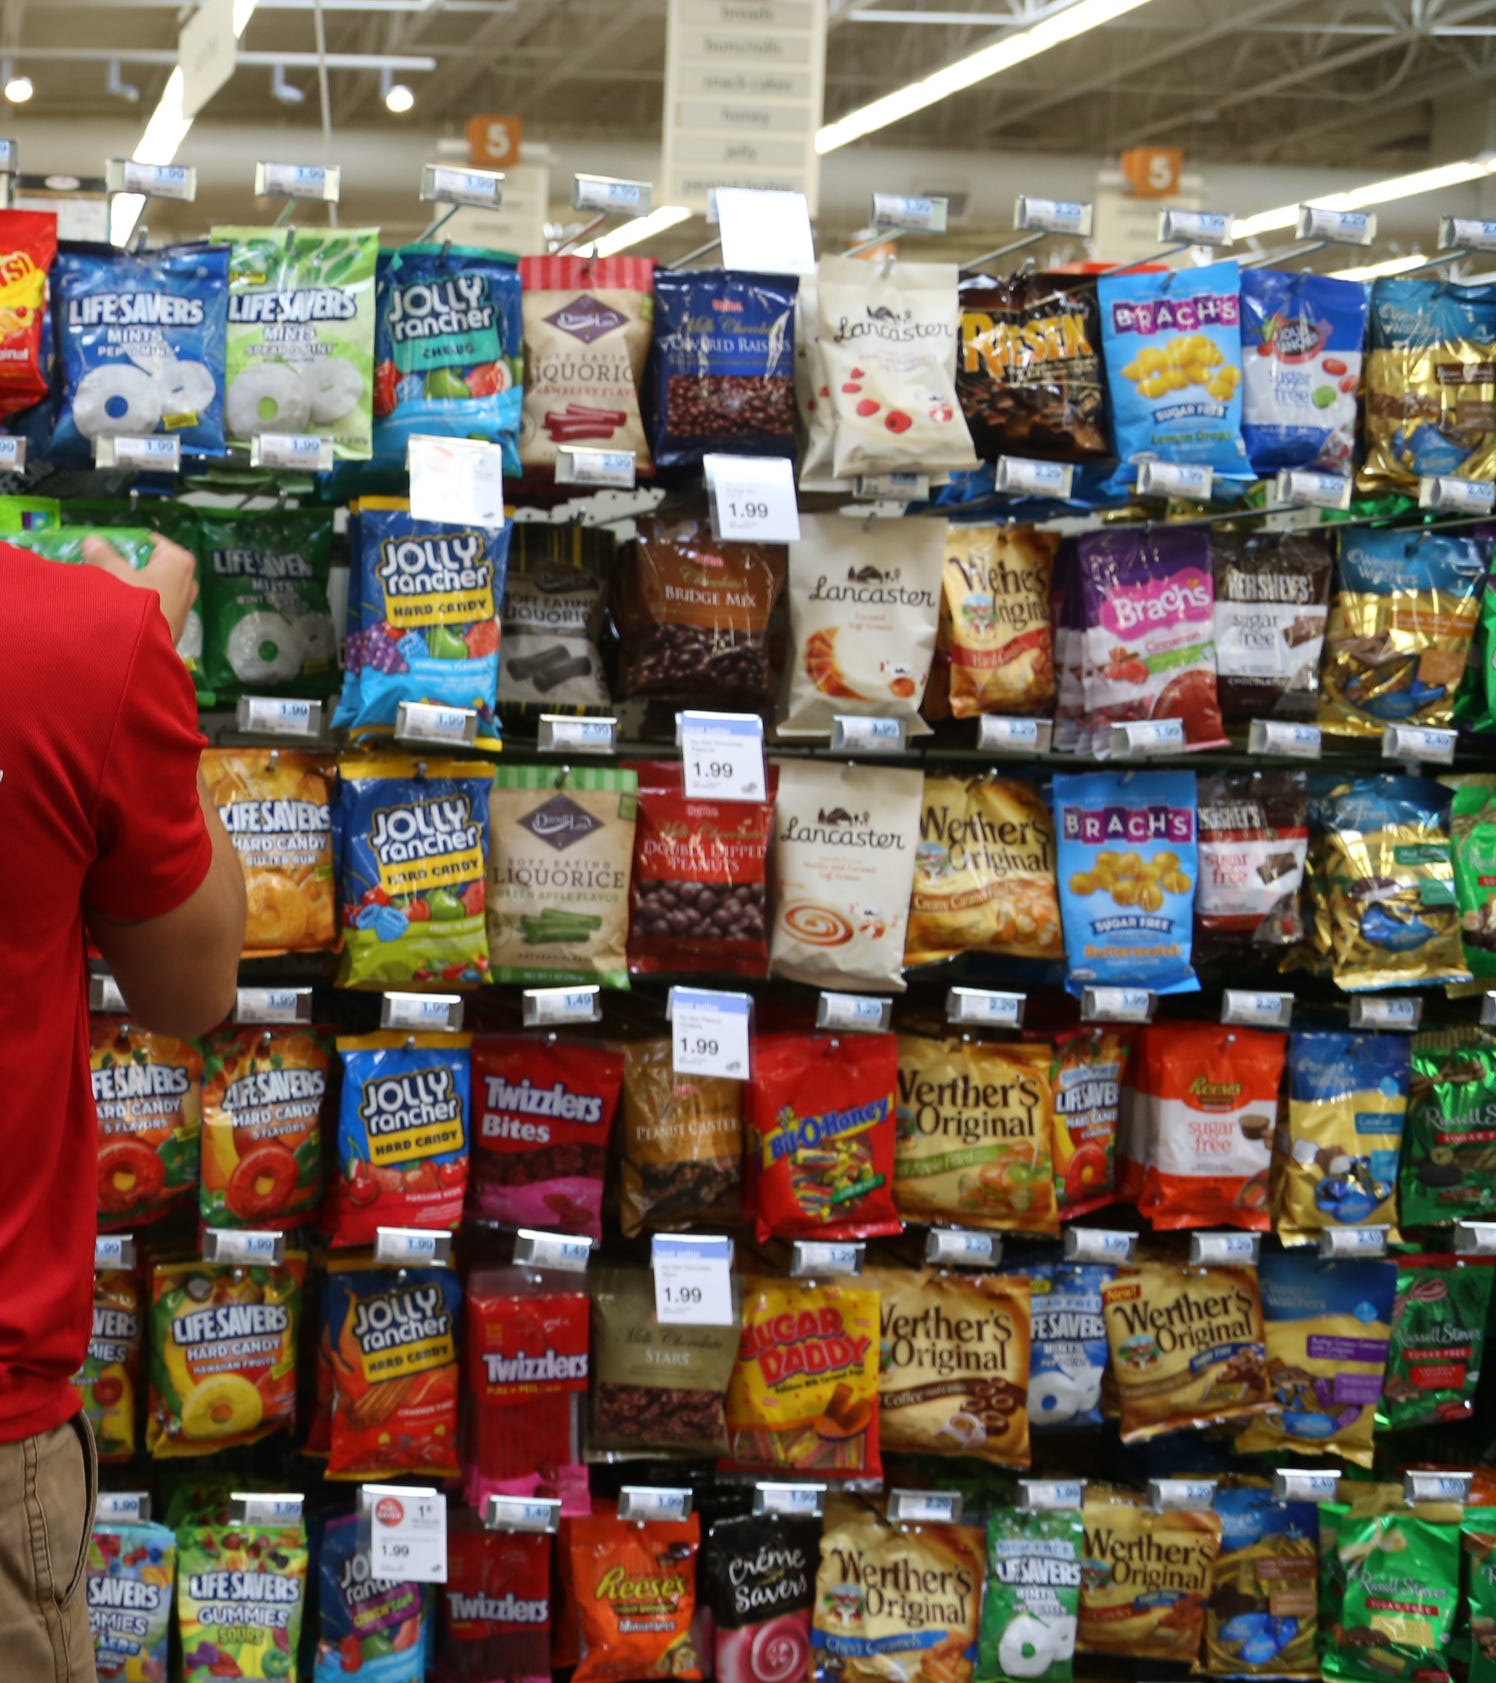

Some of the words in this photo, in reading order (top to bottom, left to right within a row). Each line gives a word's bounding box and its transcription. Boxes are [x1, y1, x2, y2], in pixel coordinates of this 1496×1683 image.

[485, 125, 510, 157] 5
[157, 168, 185, 180] 1.99
[297, 168, 326, 180] 1.99
[1147, 155, 1172, 187] 5
[386, 274, 486, 317] JOLLY
[393, 306, 494, 340] rancher
[833, 316, 954, 343] Lancaster
[106, 328, 163, 343] MINTS
[1155, 405, 1195, 421] SUGAR
[146, 439, 174, 452] 1.99
[292, 439, 320, 452] 1.99
[1151, 430, 1191, 444] Lemon
[1194, 430, 1232, 445] Drops
[729, 502, 769, 519] 1.99
[380, 535, 477, 576] JOLLY
[388, 565, 490, 595] rancher
[665, 586, 720, 606] BRIDGE
[725, 590, 756, 608] MIX
[809, 575, 936, 608] Lancaster
[392, 604, 433, 618] HARD
[438, 599, 487, 615] CANDY
[1232, 614, 1281, 636] sugar
[279, 705, 309, 717] 1.99
[435, 714, 465, 727] 1.99
[693, 761, 733, 778] 1.99
[372, 798, 467, 844] JOLLY
[918, 806, 1050, 845] Werther's
[277, 834, 326, 851] CANDY
[780, 815, 905, 850] Lancaster
[379, 829, 476, 864] rancher
[644, 841, 706, 856] DOUBLE
[711, 844, 767, 858] DIPPED
[554, 859, 611, 870] EATING
[947, 843, 1050, 876] Original
[1205, 855, 1247, 875] sugar
[387, 868, 429, 885] HARD
[433, 859, 479, 877] CANDY
[493, 868, 625, 889] LIQUORICE
[1095, 920, 1135, 931] SUGAR
[1138, 919, 1170, 930] FREE
[268, 994, 297, 1007] 1.99
[421, 1002, 449, 1013] 1.99
[565, 996, 592, 1007] 1.49
[681, 1037, 719, 1056] 1.99
[363, 1069, 450, 1113] JOLLY
[483, 1076, 603, 1123] Twizzlers
[131, 1100, 181, 1115] CANDY
[275, 1102, 321, 1120] CANDY
[370, 1100, 458, 1133] rancher
[482, 1118, 551, 1143] Bites
[916, 1104, 1035, 1143] Original
[1188, 1118, 1236, 1136] sugar
[375, 1140, 411, 1156] HARD
[414, 1129, 458, 1149] CANDY
[1195, 1134, 1232, 1153] free
[246, 1240, 273, 1251] 1.99
[408, 1239, 434, 1251] 1.99
[664, 1286, 702, 1303] 1.99
[353, 1290, 440, 1333] JOLLY
[1115, 1290, 1254, 1335] Werther's
[362, 1318, 447, 1352] rancher
[1156, 1317, 1253, 1354] Original
[187, 1345, 234, 1361] HARD
[238, 1339, 281, 1356] CANDY
[368, 1356, 405, 1373] HARD
[407, 1345, 449, 1364] CANDY
[644, 1349, 691, 1365] STARS
[758, 1334, 870, 1387] DADDY
[891, 1338, 1007, 1375] Original
[1408, 1349, 1441, 1359] SUGAR
[1443, 1348, 1466, 1357] FREE
[483, 1351, 588, 1382] Twizzlers
[884, 1390, 923, 1406] Coffee
[382, 1545, 409, 1556] 1.99
[1084, 1529, 1213, 1566] Werther's
[832, 1548, 972, 1598] Werther's
[1112, 1563, 1205, 1592] Original
[198, 1607, 290, 1625] GUMMIES
[448, 1592, 548, 1622] Twizzlers
[865, 1588, 966, 1627] Original
[217, 1628, 265, 1645] SOURS
